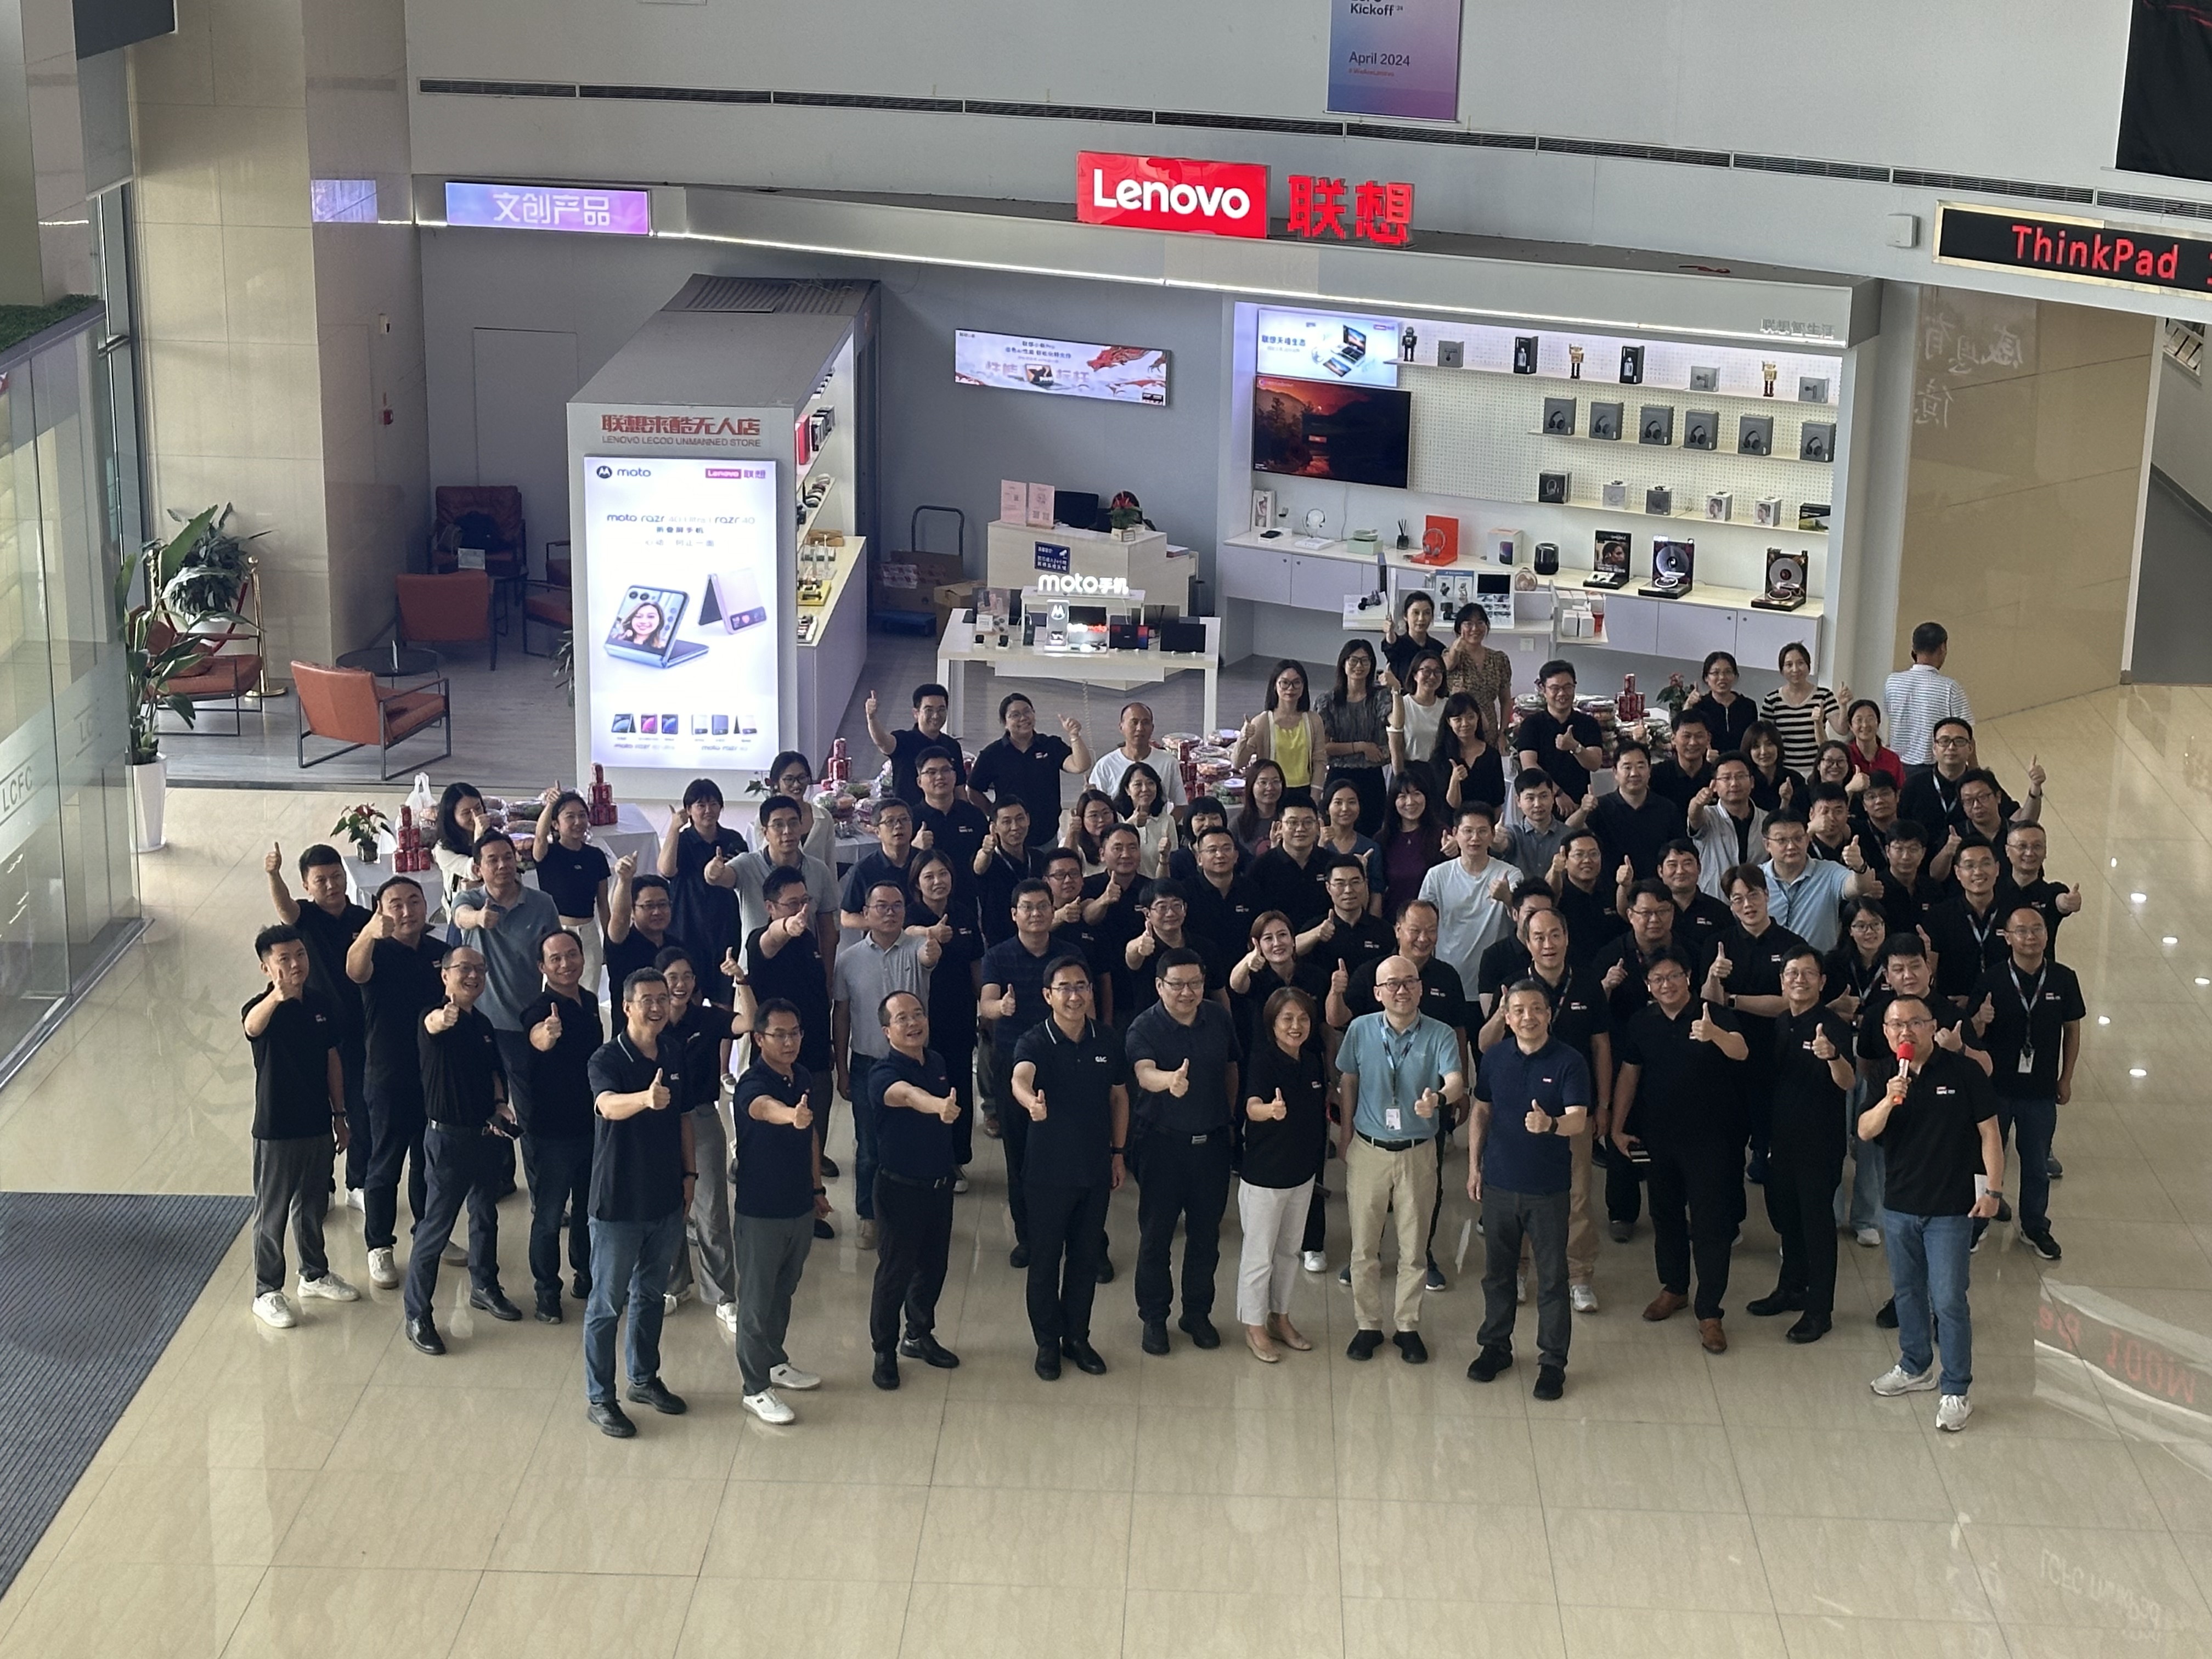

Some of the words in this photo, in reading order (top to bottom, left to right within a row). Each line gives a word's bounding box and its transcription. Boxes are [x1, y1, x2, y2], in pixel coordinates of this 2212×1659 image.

[1351, 3, 1394, 16] Kickoff
[1348, 51, 1377, 65] April
[1380, 53, 1410, 66] 2024
[493, 192, 611, 226] 文创产品
[1093, 169, 1250, 219] Lenovo
[1287, 176, 1415, 246] 联想
[2011, 225, 2179, 281] ThinkPad
[602, 415, 760, 436] 联想来酷无人店
[602, 436, 639, 445] LENOVO
[642, 437, 673, 445] LECOO
[675, 437, 727, 446] UNMANNED
[730, 439, 761, 447] STORE
[617, 467, 651, 477] moto
[744, 470, 766, 479] 联想
[607, 514, 637, 522] moto
[1038, 573, 1129, 595] moto手机
[2, 766, 33, 812] LCFC
